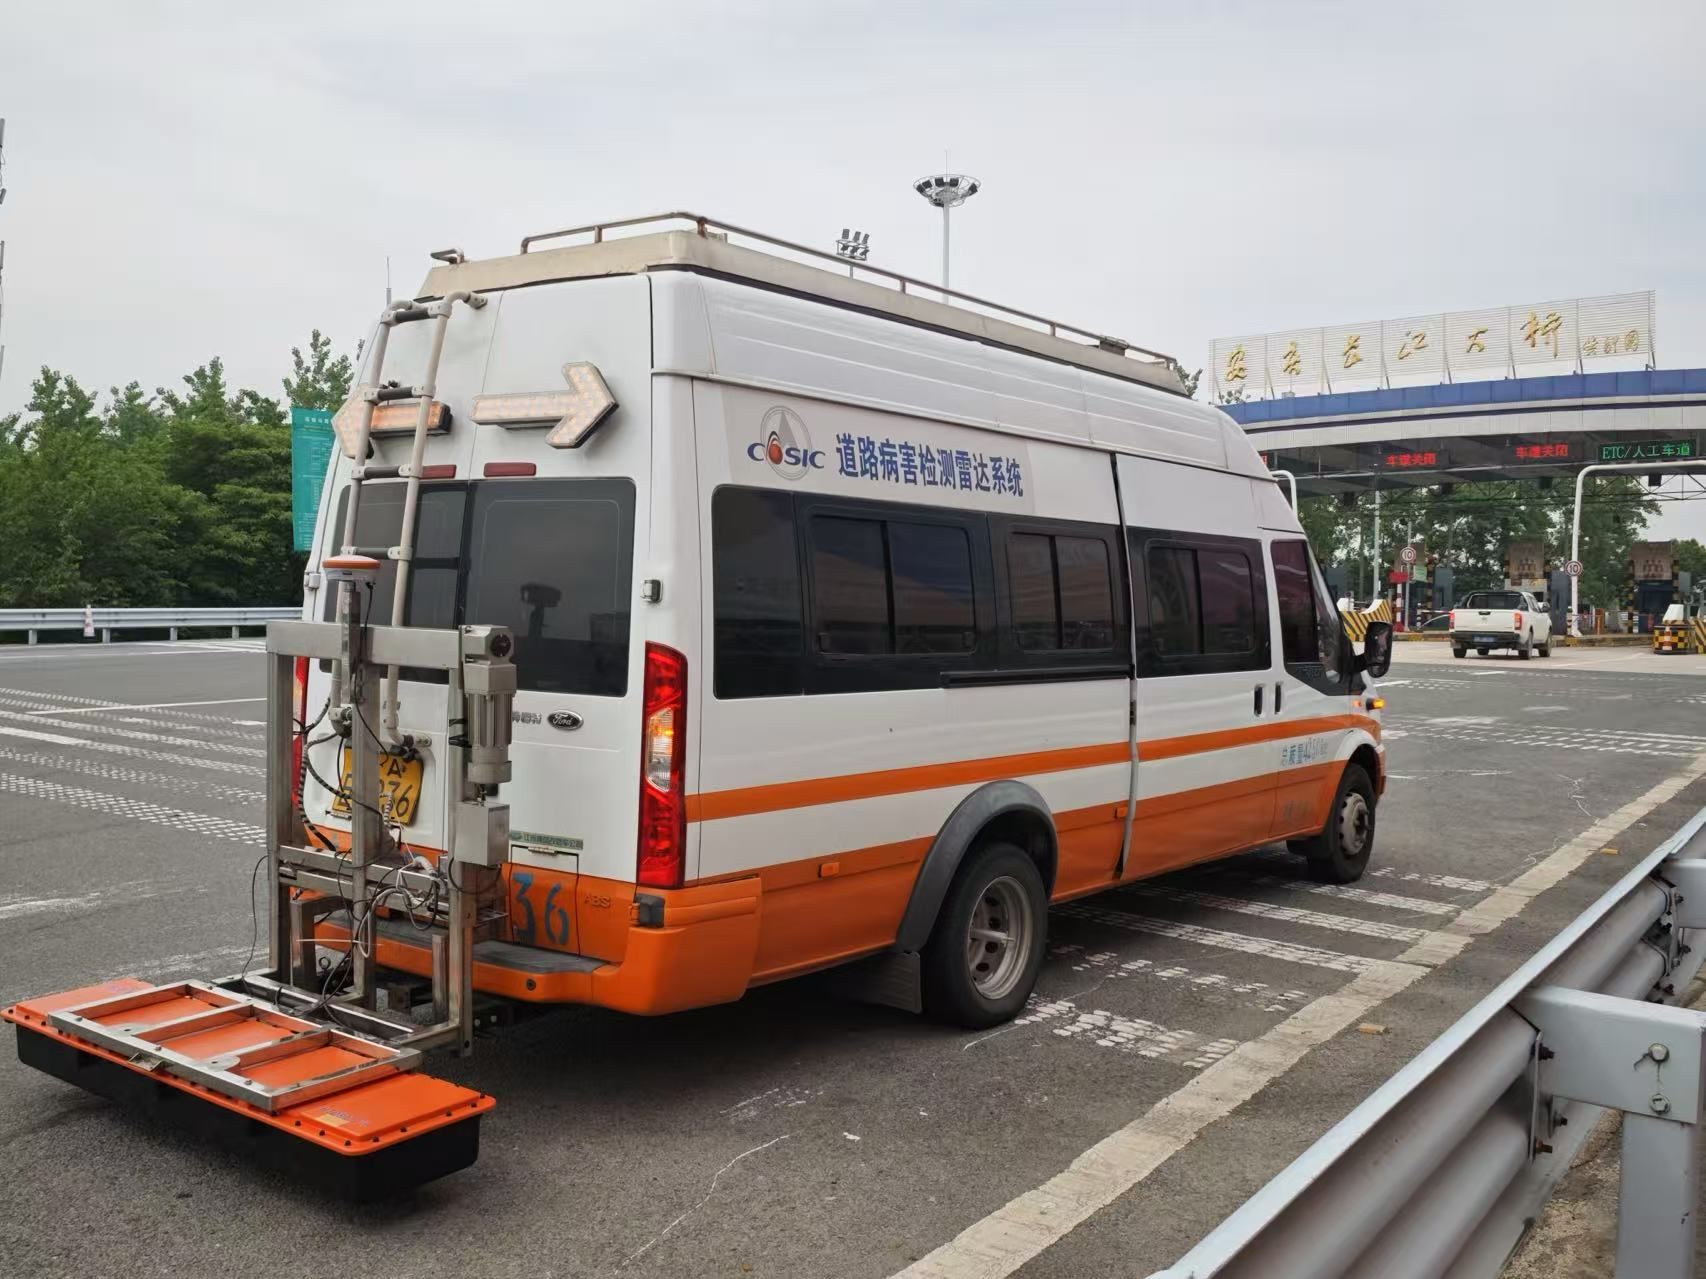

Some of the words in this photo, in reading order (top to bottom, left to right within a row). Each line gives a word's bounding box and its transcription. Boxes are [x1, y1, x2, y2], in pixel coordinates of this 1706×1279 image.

[836, 433, 1024, 497] 道路病害检测雷达系统
[1602, 445, 1690, 460] ETC/人工车道
[1569, 564, 1579, 573] 10
[512, 872, 569, 946] 36
